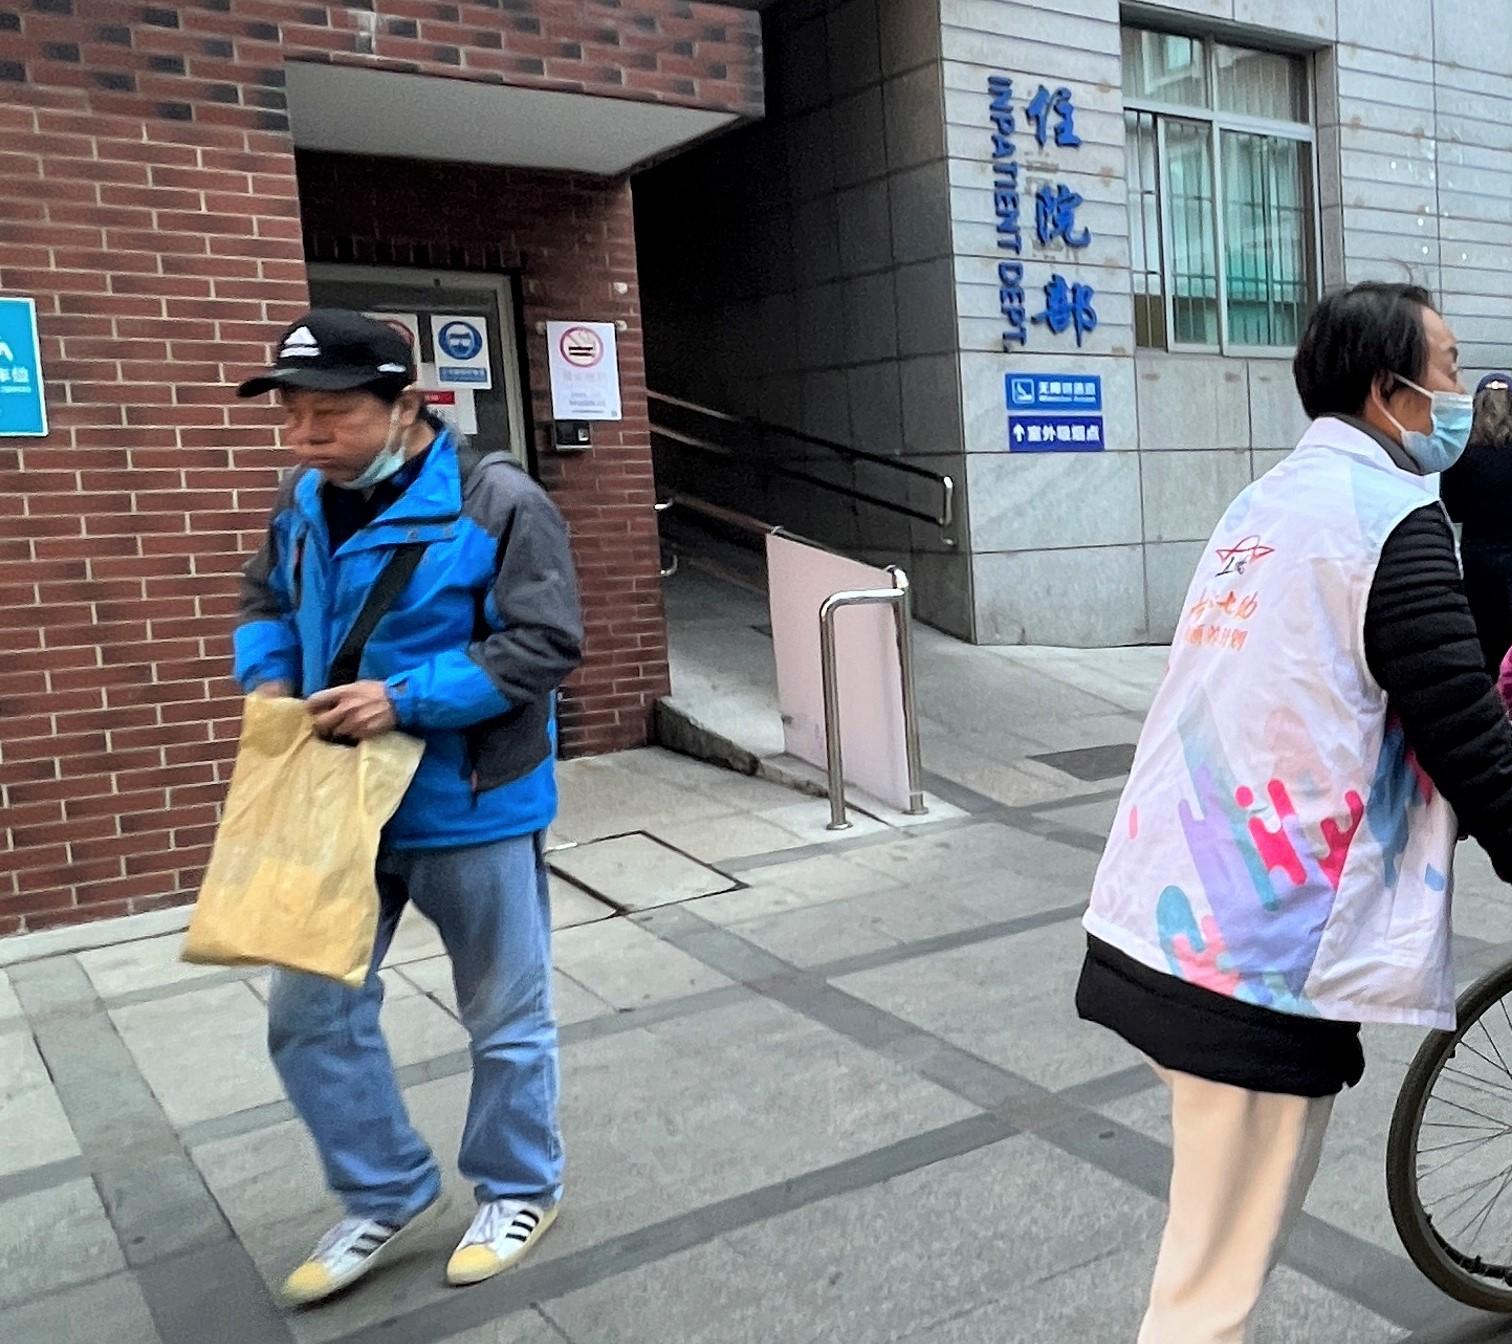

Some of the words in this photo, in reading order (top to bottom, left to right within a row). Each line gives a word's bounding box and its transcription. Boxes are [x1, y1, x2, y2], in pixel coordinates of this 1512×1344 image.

[987, 75, 1022, 255] INPATIENT
[1025, 84, 1098, 348] 住院部
